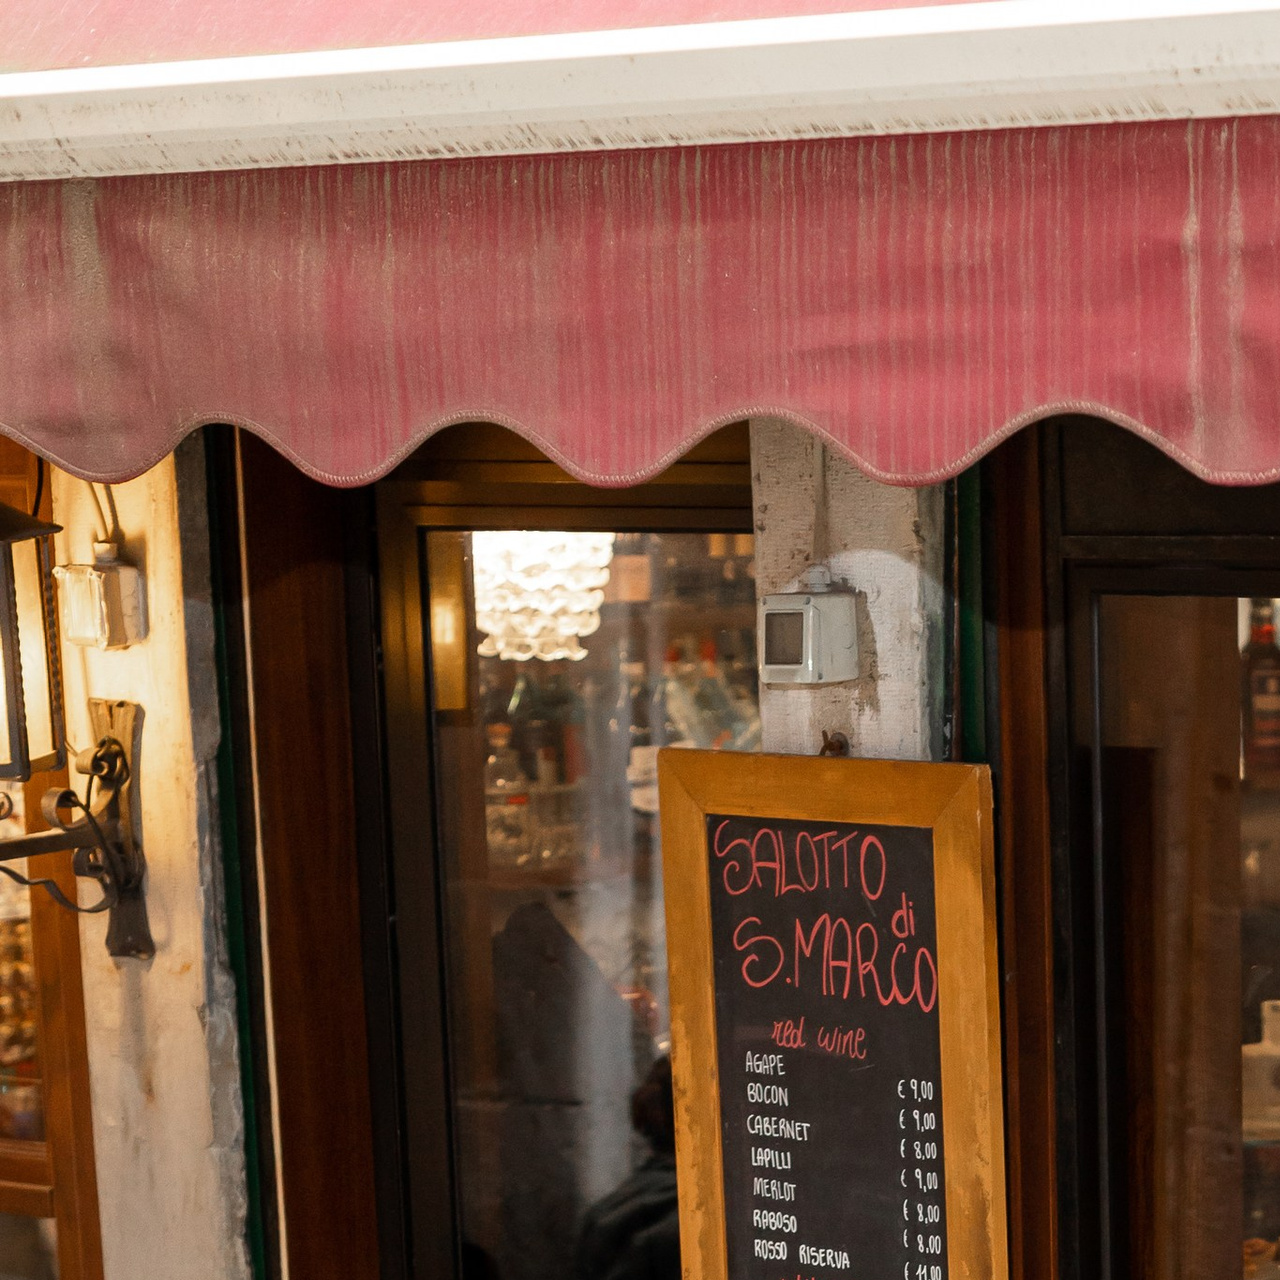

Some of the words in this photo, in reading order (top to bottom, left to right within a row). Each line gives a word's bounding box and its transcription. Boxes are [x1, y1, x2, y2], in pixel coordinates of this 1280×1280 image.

[713, 819, 887, 901] SALOTTO
[890, 891, 916, 939] di
[771, 1016, 807, 1049] red
[817, 1026, 867, 1060] wine
[745, 1050, 786, 1076] AGAPE
[746, 1082, 789, 1107] BOCON
[746, 1113, 811, 1142] CABERNET
[751, 1146, 792, 1170] LAPILLI
[753, 1176, 797, 1202] MERLOT
[752, 1208, 798, 1234] RABOSO
[753, 1238, 788, 1261] ROSSO
[798, 1243, 851, 1270] RISERVA
